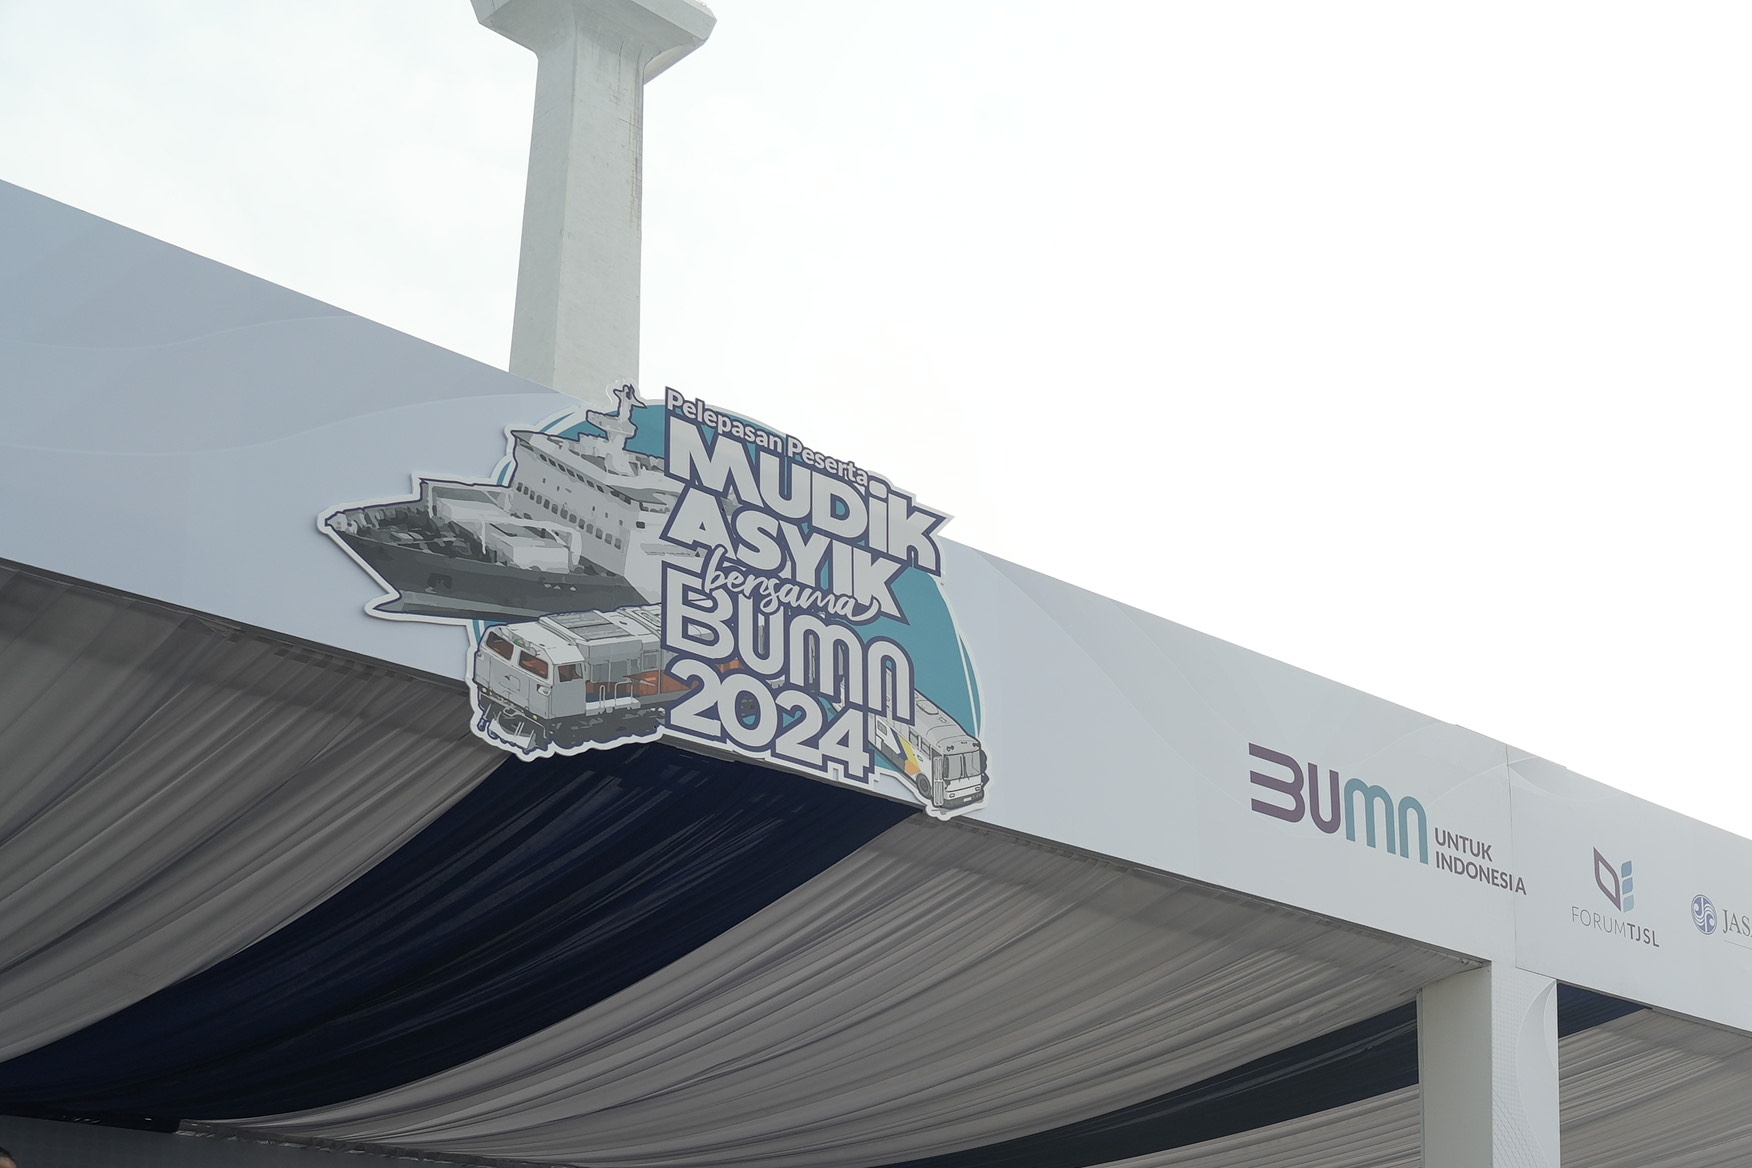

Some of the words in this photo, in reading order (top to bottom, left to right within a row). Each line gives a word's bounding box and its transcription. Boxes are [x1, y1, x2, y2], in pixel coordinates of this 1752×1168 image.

[666, 388, 783, 455] Pelepasan
[786, 436, 868, 487] Peserta
[661, 478, 907, 622] ASYIK
[702, 545, 880, 621] bersama
[666, 660, 873, 783] 2024
[1248, 742, 1429, 866] BUMN
[1434, 827, 1494, 863] UNTUK
[1434, 851, 1527, 897] INDONESIA
